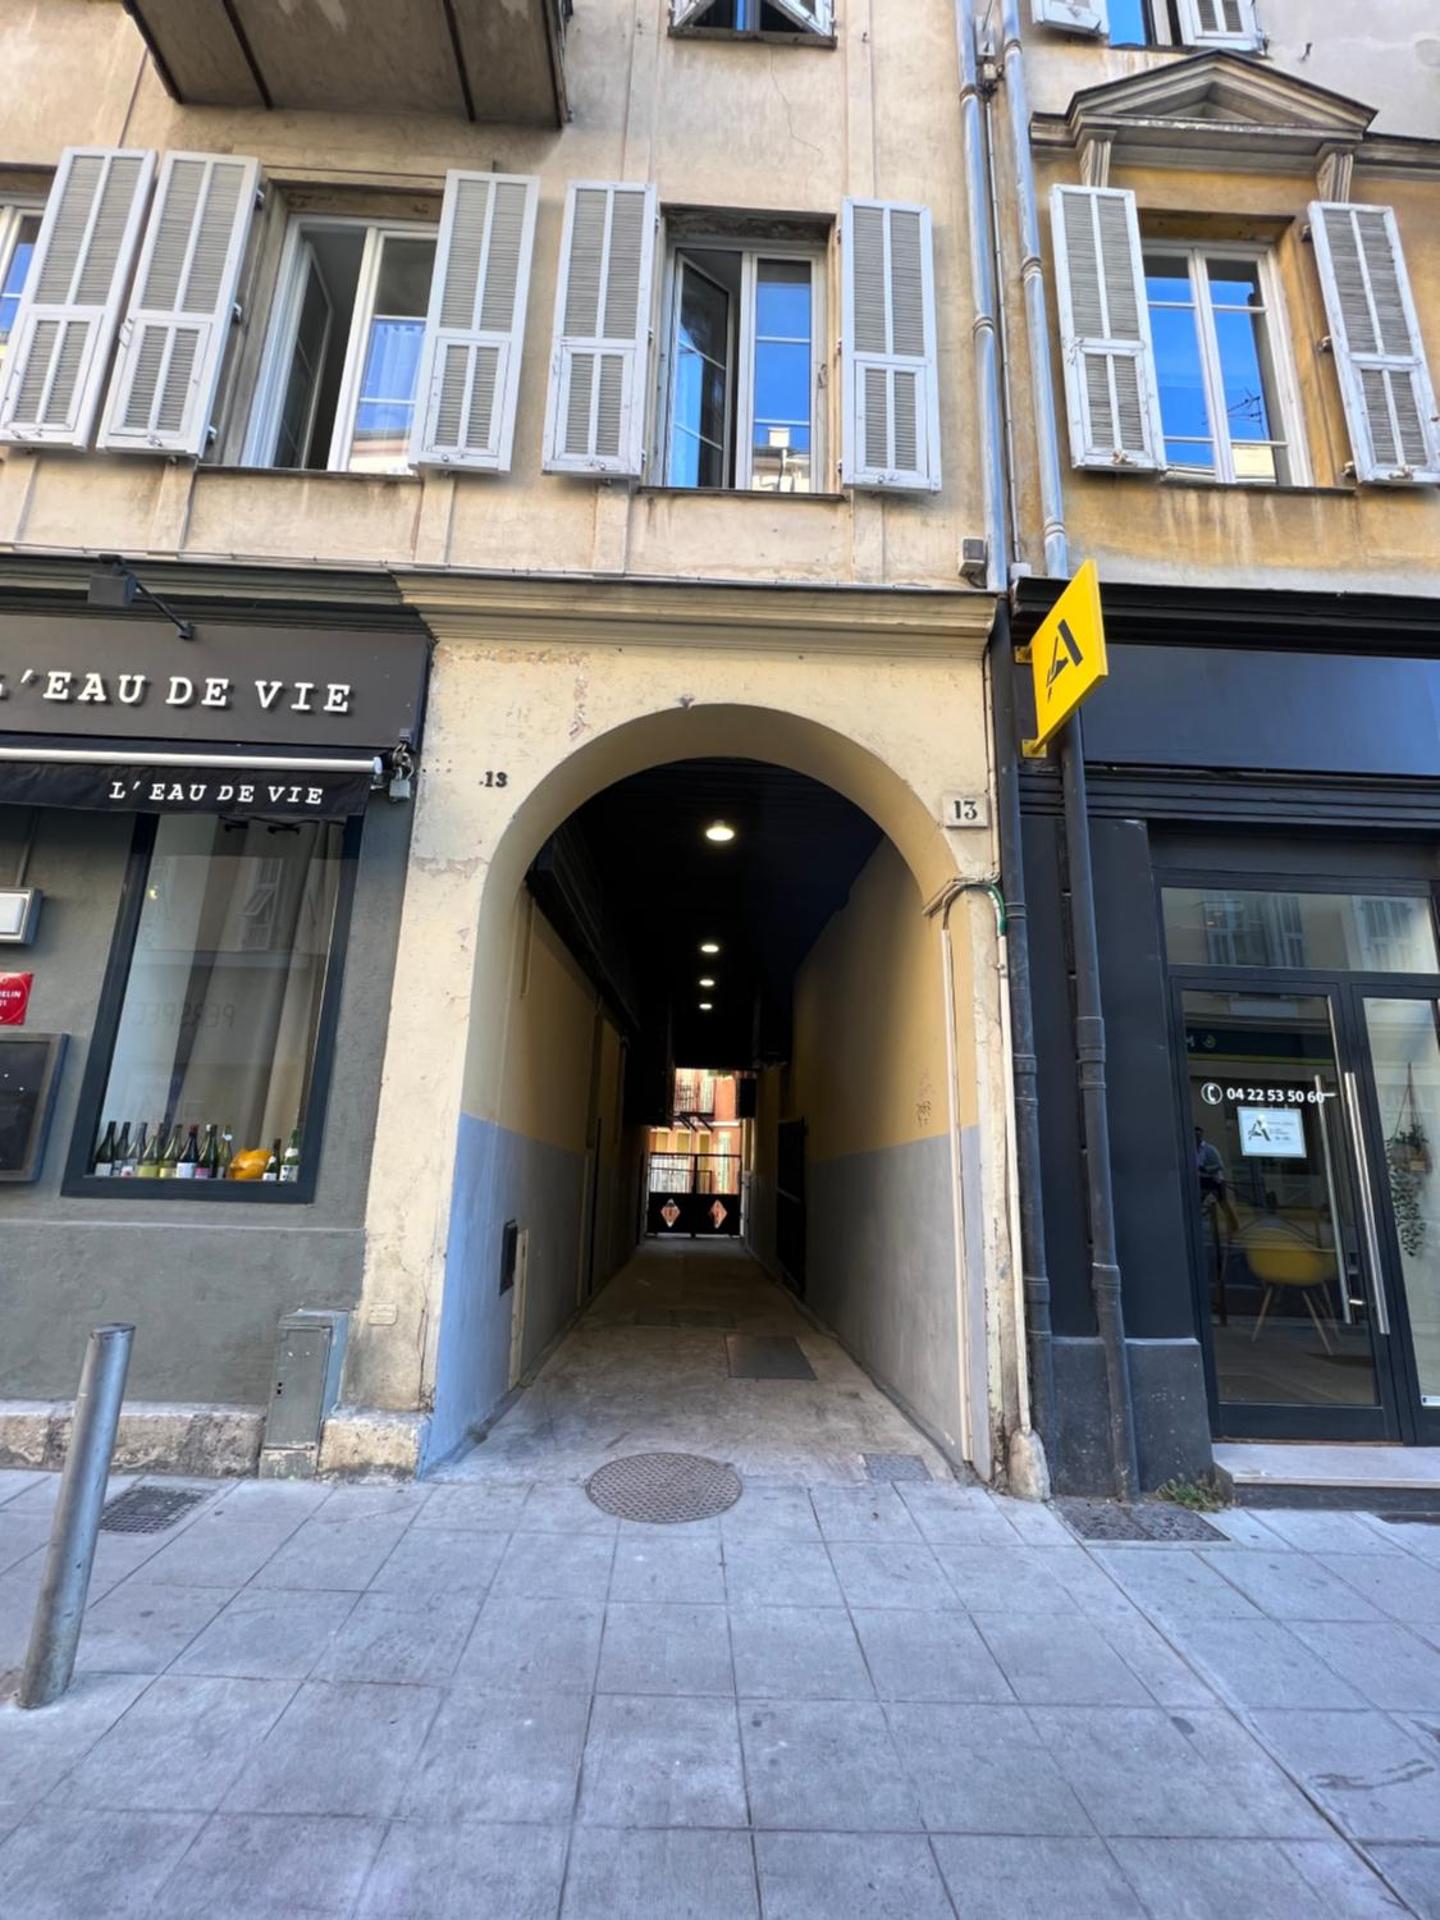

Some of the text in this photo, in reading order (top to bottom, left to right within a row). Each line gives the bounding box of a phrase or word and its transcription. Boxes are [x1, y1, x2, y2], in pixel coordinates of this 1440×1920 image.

[0, 669, 351, 712] 'EAU DE VIE
[484, 770, 508, 788] 13
[109, 781, 324, 805] L'EAU DE VIE
[954, 800, 978, 820] 13
[1226, 1087, 1325, 1104] 04 22 53 50 60
